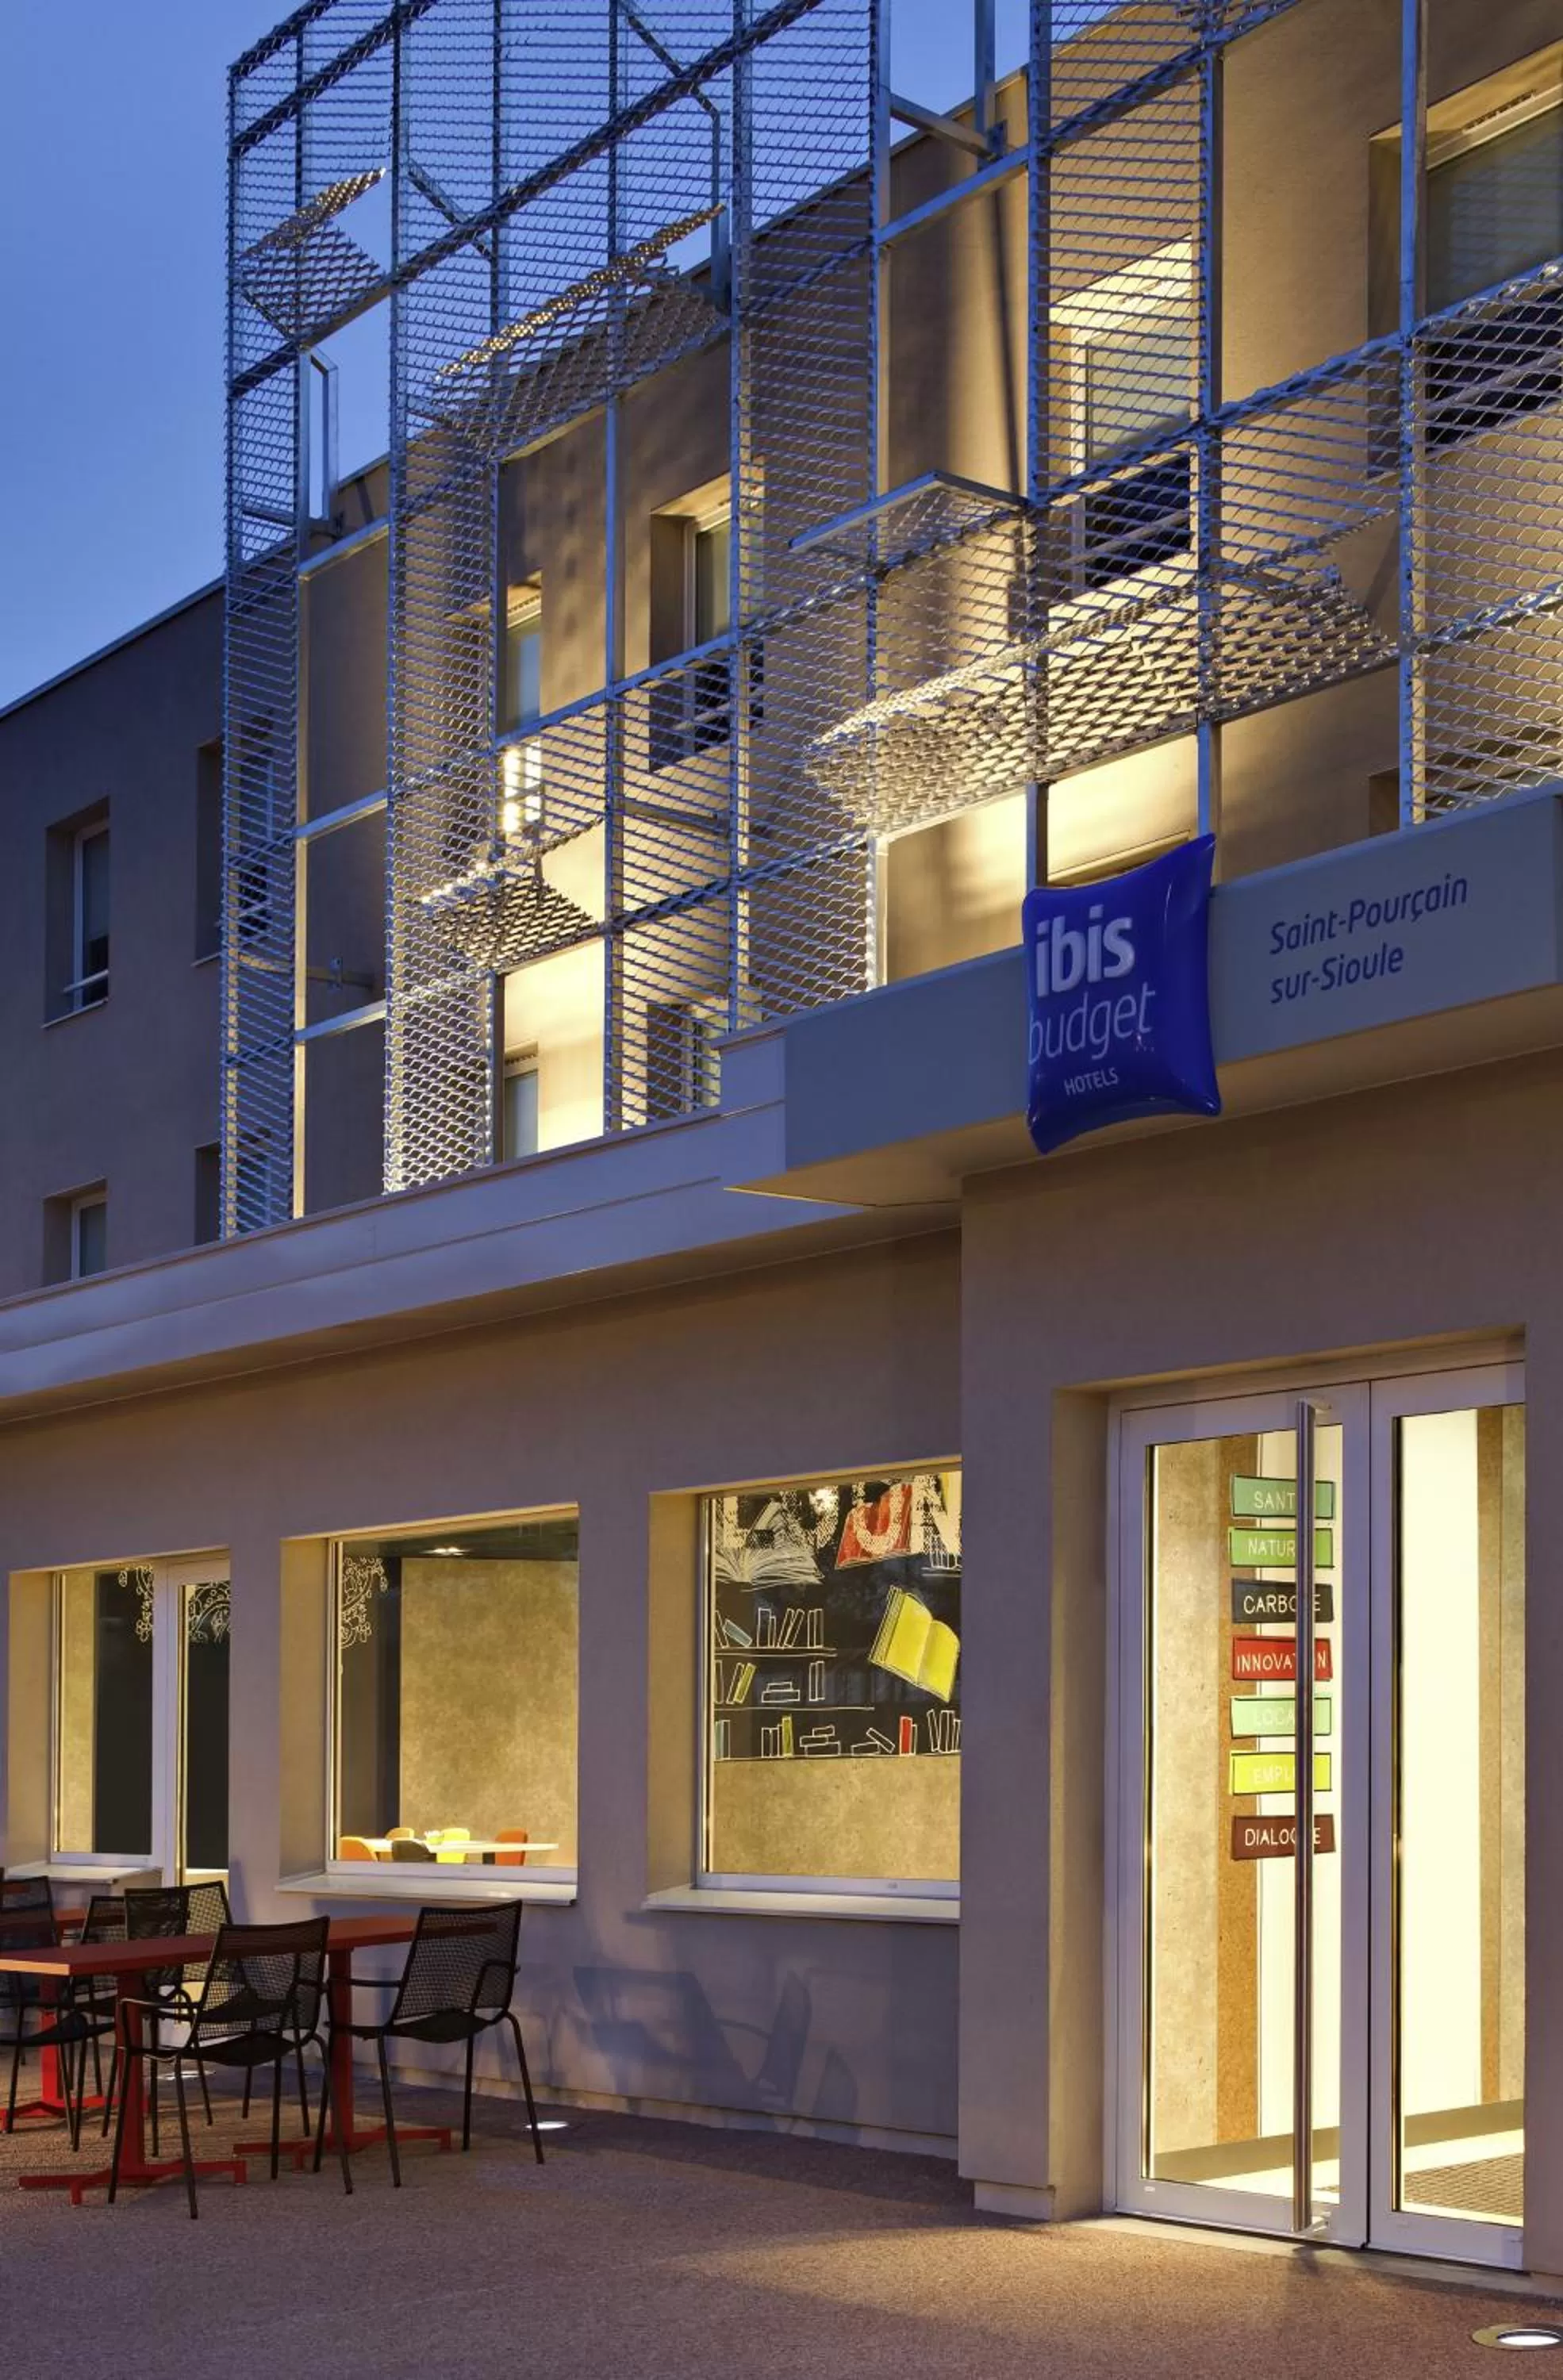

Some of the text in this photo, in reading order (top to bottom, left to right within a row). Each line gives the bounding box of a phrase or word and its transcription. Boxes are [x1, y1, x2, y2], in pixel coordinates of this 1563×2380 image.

[1270, 873, 1468, 955] Saint-Pourçain
[1036, 904, 1135, 997] ibis
[1270, 942, 1404, 1004] sur-Sioule
[1028, 982, 1156, 1065] budget
[1064, 1067, 1119, 1095] HOTELS
[1254, 1491, 1296, 1511] SANT
[1248, 1537, 1296, 1557] NATUR
[1243, 1594, 1321, 1614] CARBOE
[1237, 1650, 1327, 1673] INNOVAN
[1245, 1827, 1321, 1847] DIALOE
